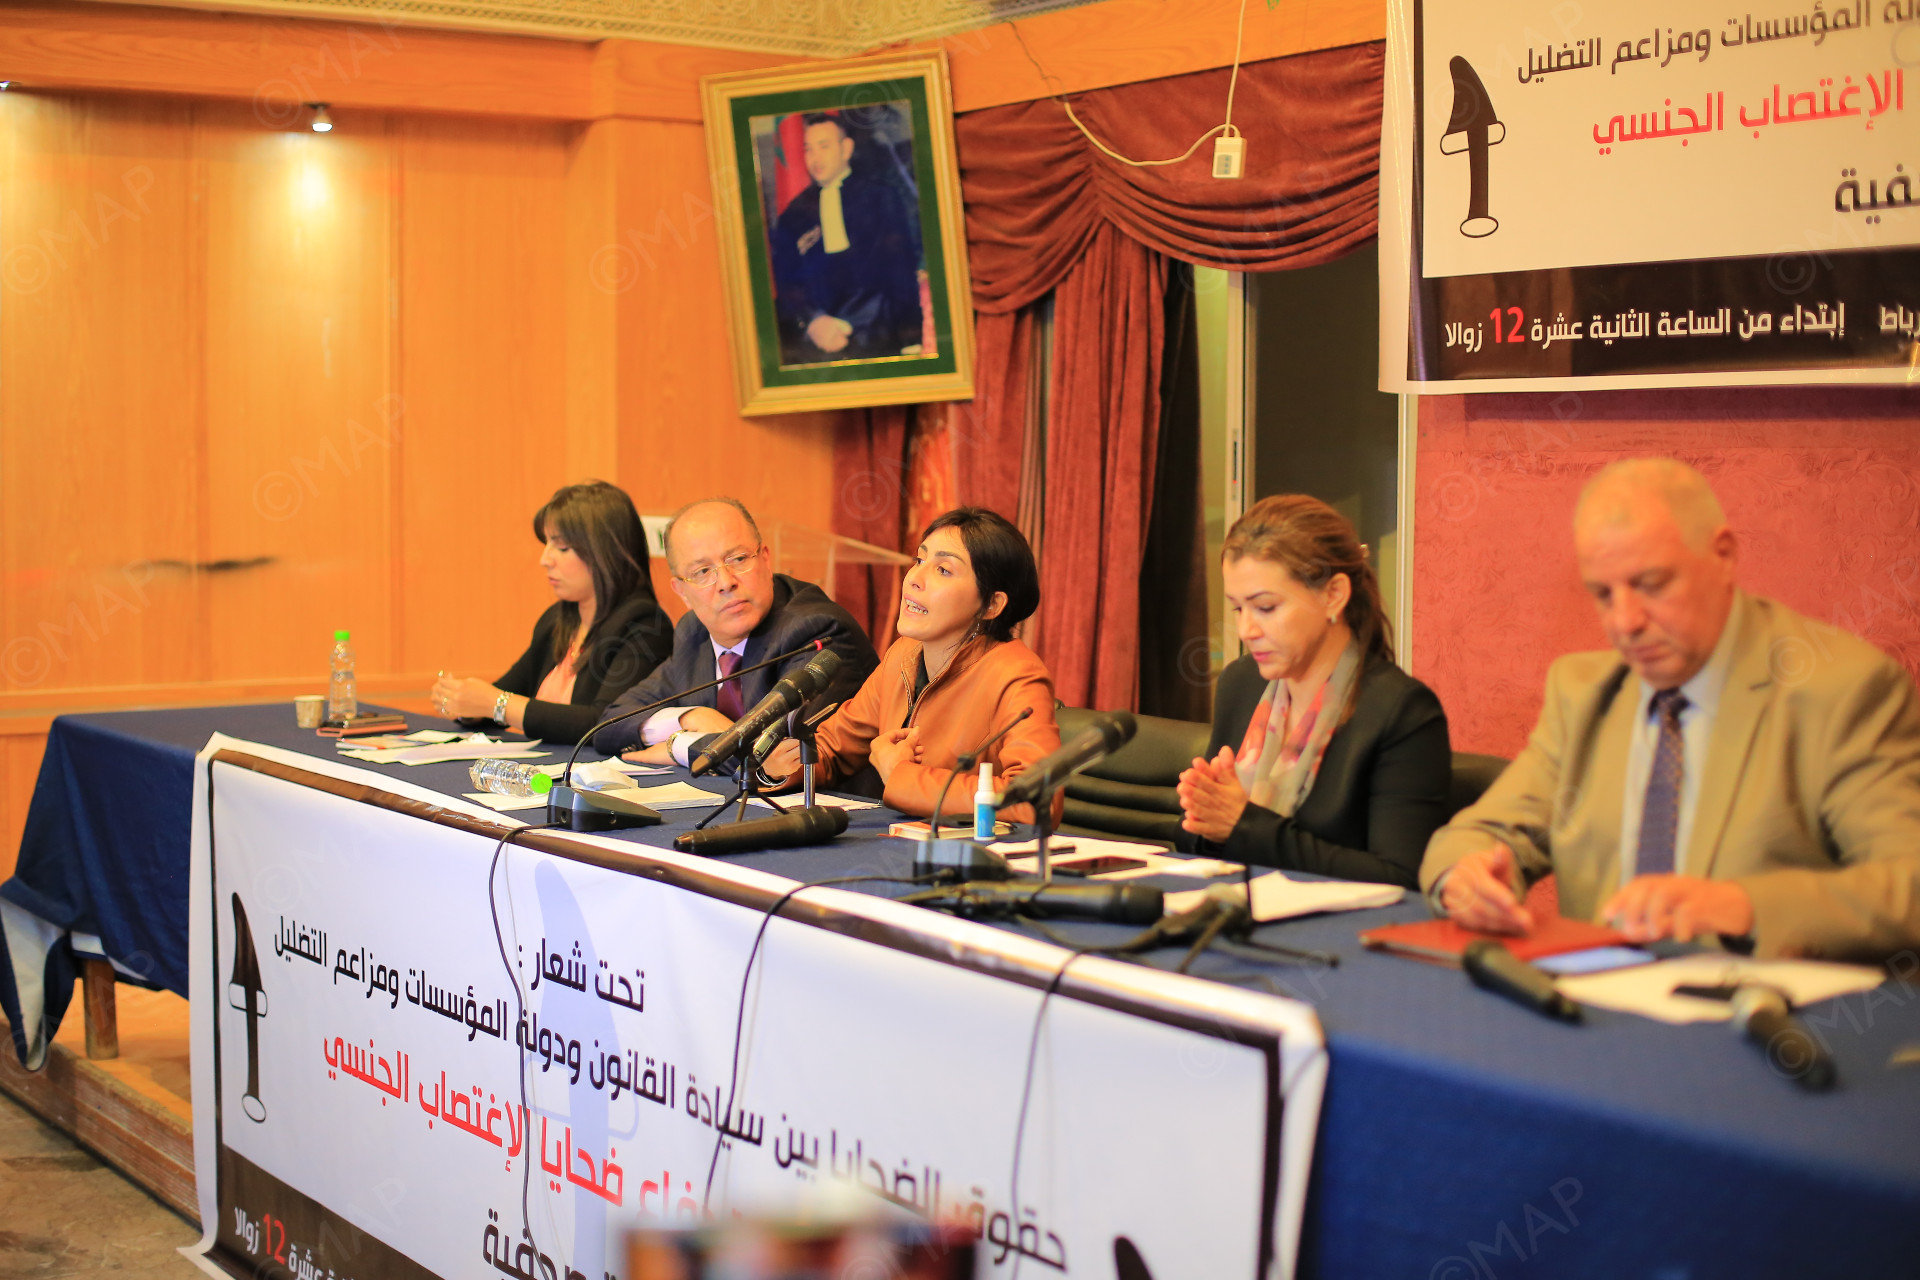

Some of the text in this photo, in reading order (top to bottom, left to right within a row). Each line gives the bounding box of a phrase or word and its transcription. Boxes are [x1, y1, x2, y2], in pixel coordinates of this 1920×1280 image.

[1610, 28, 1711, 75] ومزاعم
[1721, 0, 1871, 47] المؤسسات
[1518, 37, 1601, 84] التضليل
[1592, 68, 1904, 155] الإغتصاب الجنسي
[1444, 302, 1845, 353] إبتداء من الساعة الثانية عشرة 12 زوالا
[274, 915, 328, 968] التضليل
[530, 936, 588, 992] شعار
[333, 946, 399, 1010] ومزاعم
[405, 968, 508, 1042] المؤسسات
[594, 968, 646, 1014] تحت
[324, 1036, 409, 1107] الجنسي
[515, 1008, 581, 1086] ودولة
[589, 1043, 676, 1109] القانون
[685, 1072, 764, 1152] سيادة
[541, 1116, 623, 1208] ضحايا
[774, 1113, 819, 1183] بين
[234, 1206, 260, 1256] زوالا
[263, 1213, 286, 1266] 12
